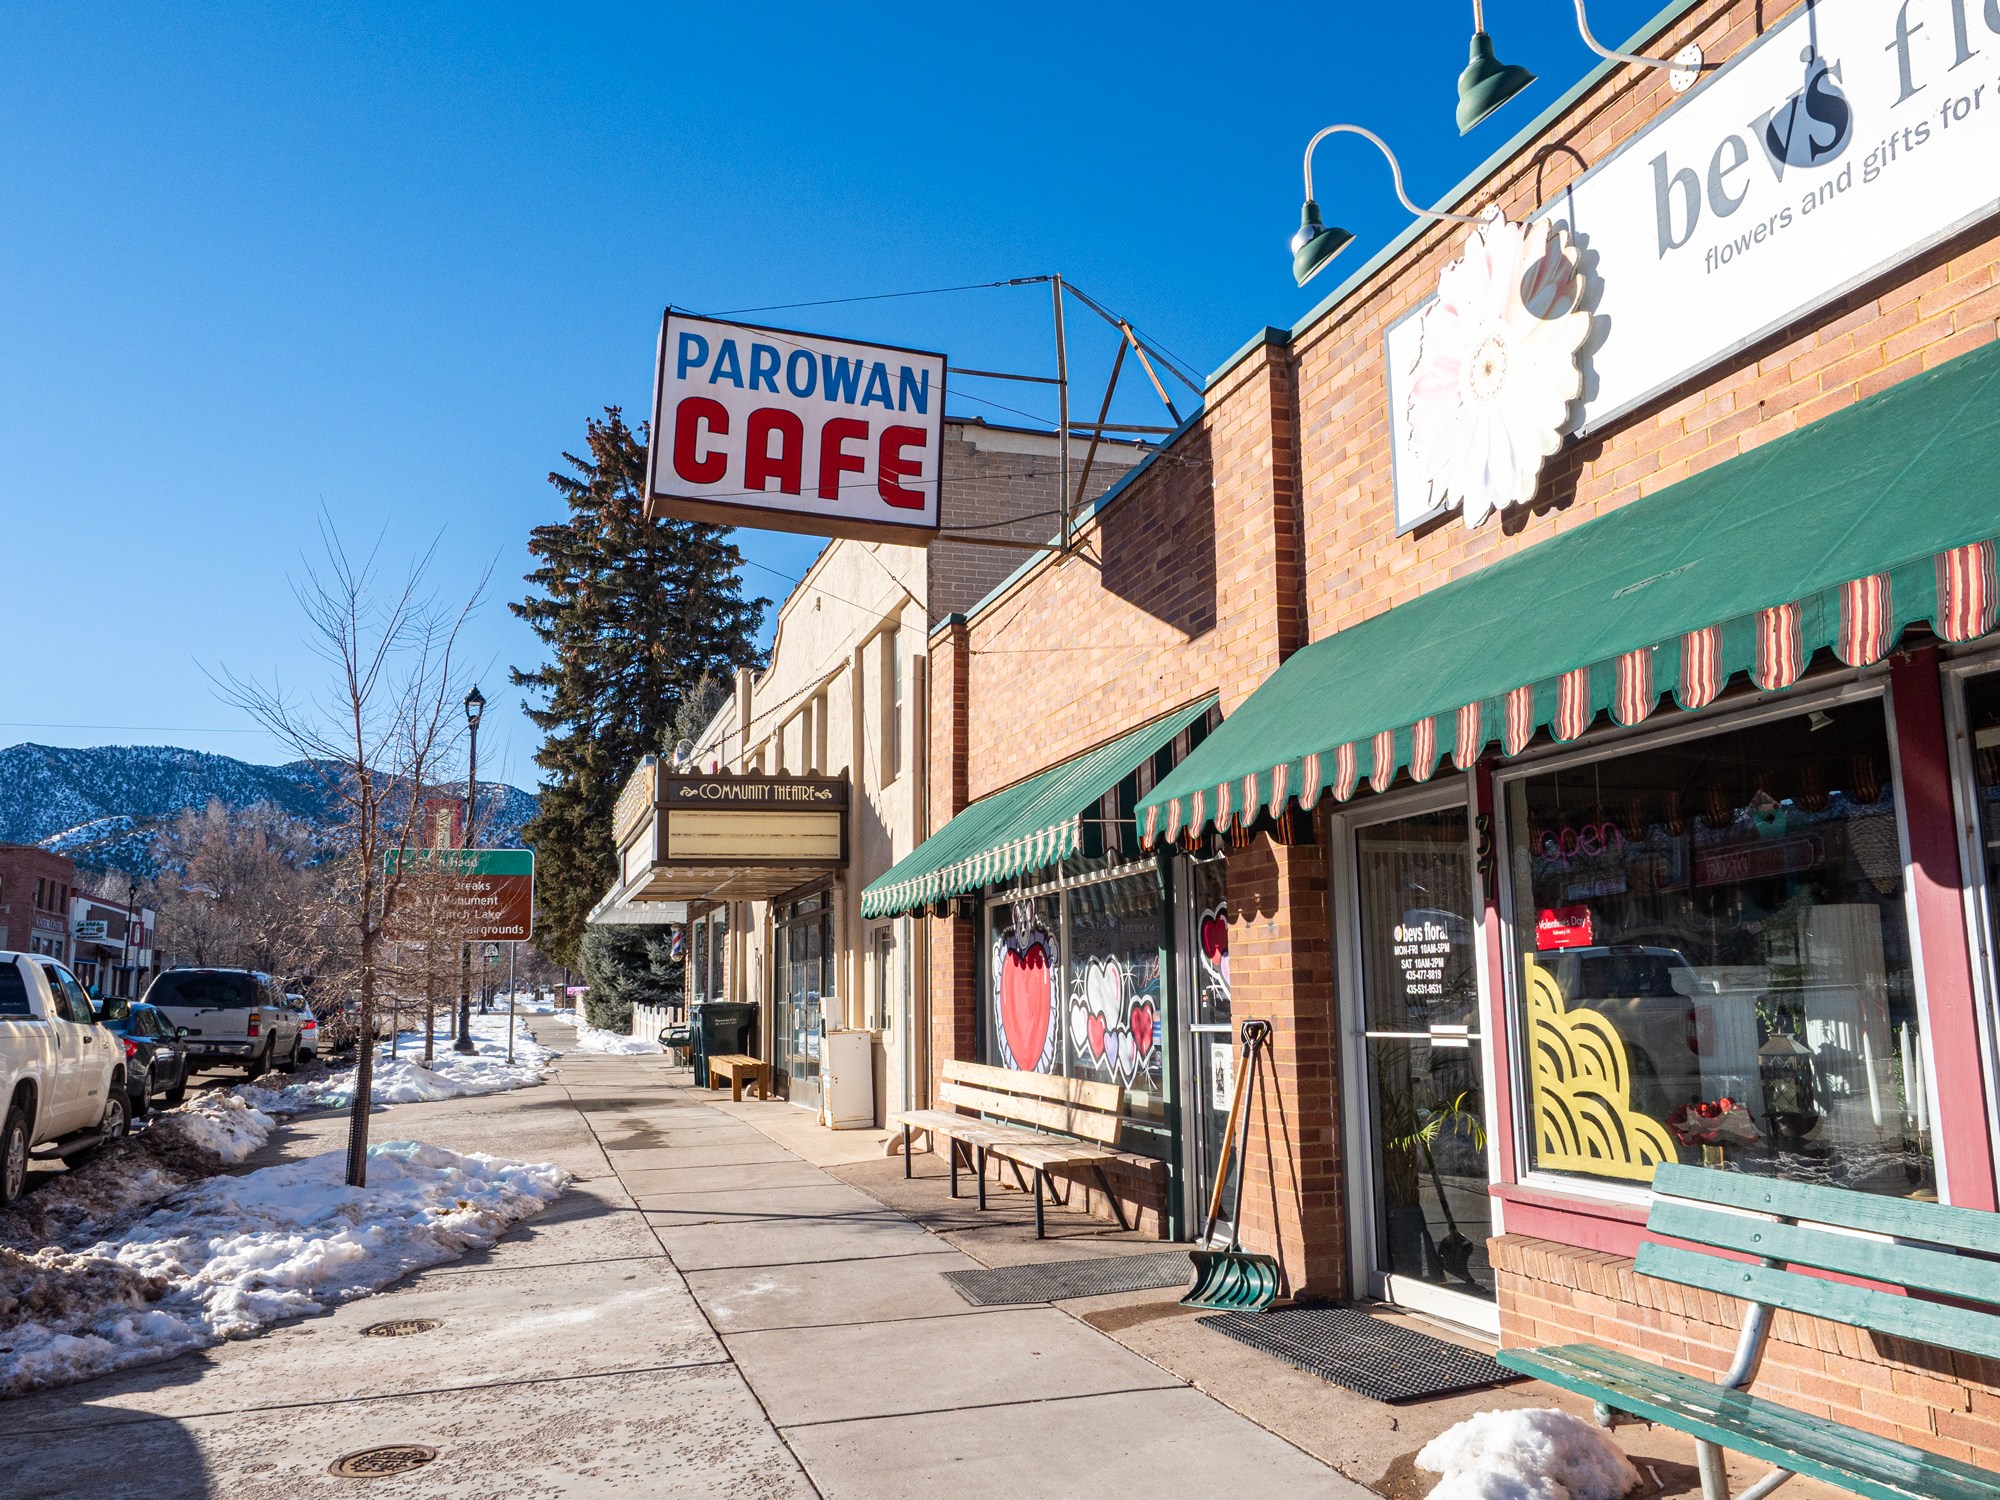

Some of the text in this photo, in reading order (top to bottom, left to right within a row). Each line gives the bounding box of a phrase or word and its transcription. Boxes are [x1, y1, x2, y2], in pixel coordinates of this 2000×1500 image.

[1704, 206, 1793, 274] flowers
[1801, 162, 1852, 216] and
[1862, 121, 1931, 184] gifts
[1940, 84, 1985, 129] for
[676, 331, 930, 415] PAROWAN
[673, 396, 928, 511] CAFE
[699, 783, 815, 801] COMMUNITY THEATRE
[1539, 822, 1622, 868] open
[475, 910, 501, 919] Lake
[1571, 916, 1587, 928] Day
[1402, 920, 1448, 942] bevs floral
[1394, 945, 1419, 956] MON-FRI
[1401, 959, 1412, 969] SAT
